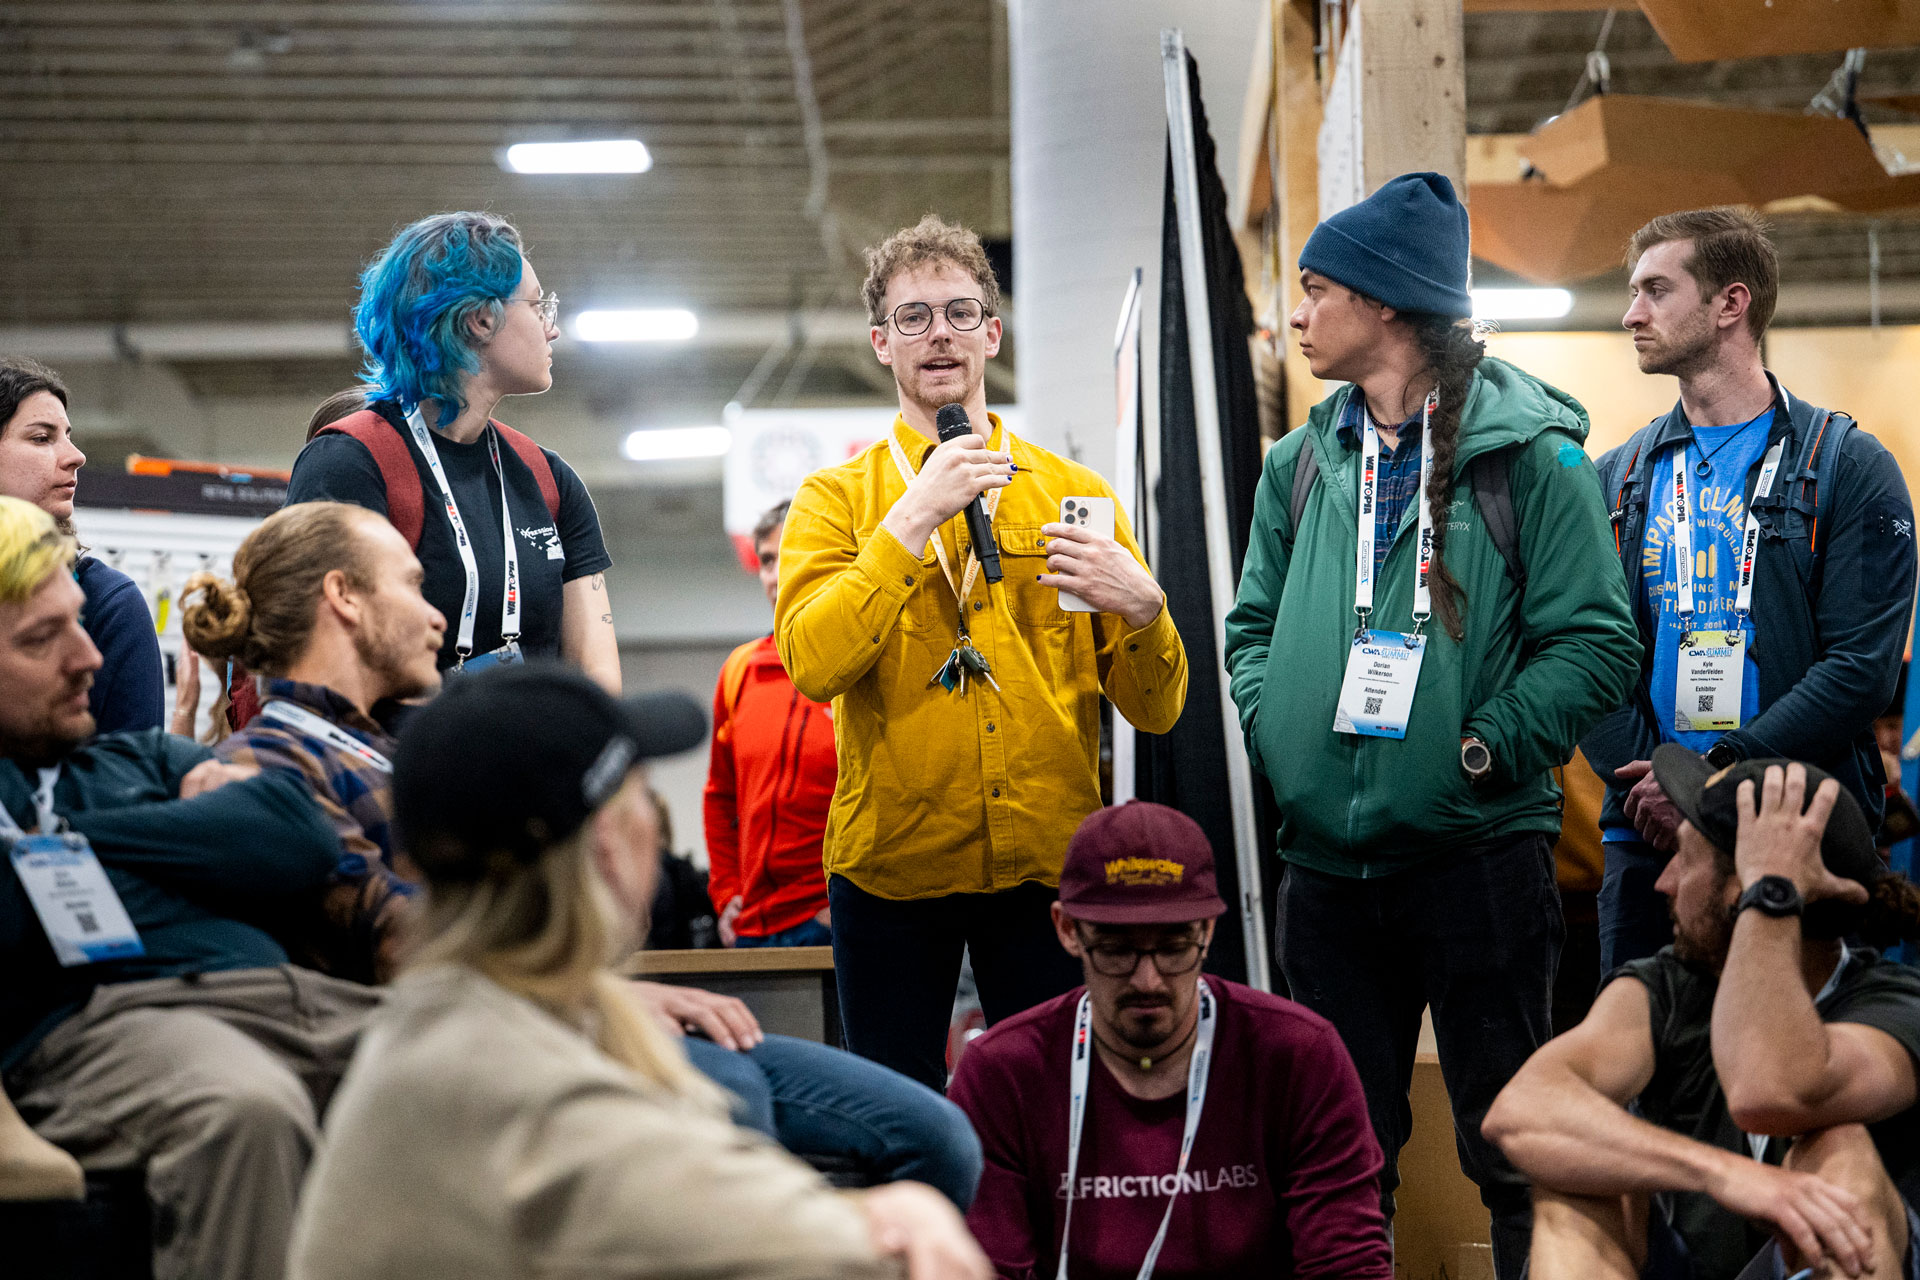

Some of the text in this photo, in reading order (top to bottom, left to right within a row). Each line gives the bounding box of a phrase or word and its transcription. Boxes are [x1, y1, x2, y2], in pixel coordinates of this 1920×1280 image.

[1363, 455, 1375, 515] WALLTOPIA
[1676, 471, 1686, 523] WALLTOPIA
[1446, 522, 1471, 532] TERYX
[1679, 546, 1689, 590] CompositeX
[1742, 528, 1757, 586] WALLTOPIA
[507, 560, 517, 616] WALLTOPIA
[1663, 598, 1680, 614] TH
[1381, 650, 1409, 658] SUMMIT
[1364, 687, 1387, 695] Attendee
[1368, 669, 1392, 677] Wilkerson
[1078, 1163, 1259, 1199] FRICTIONLABS
